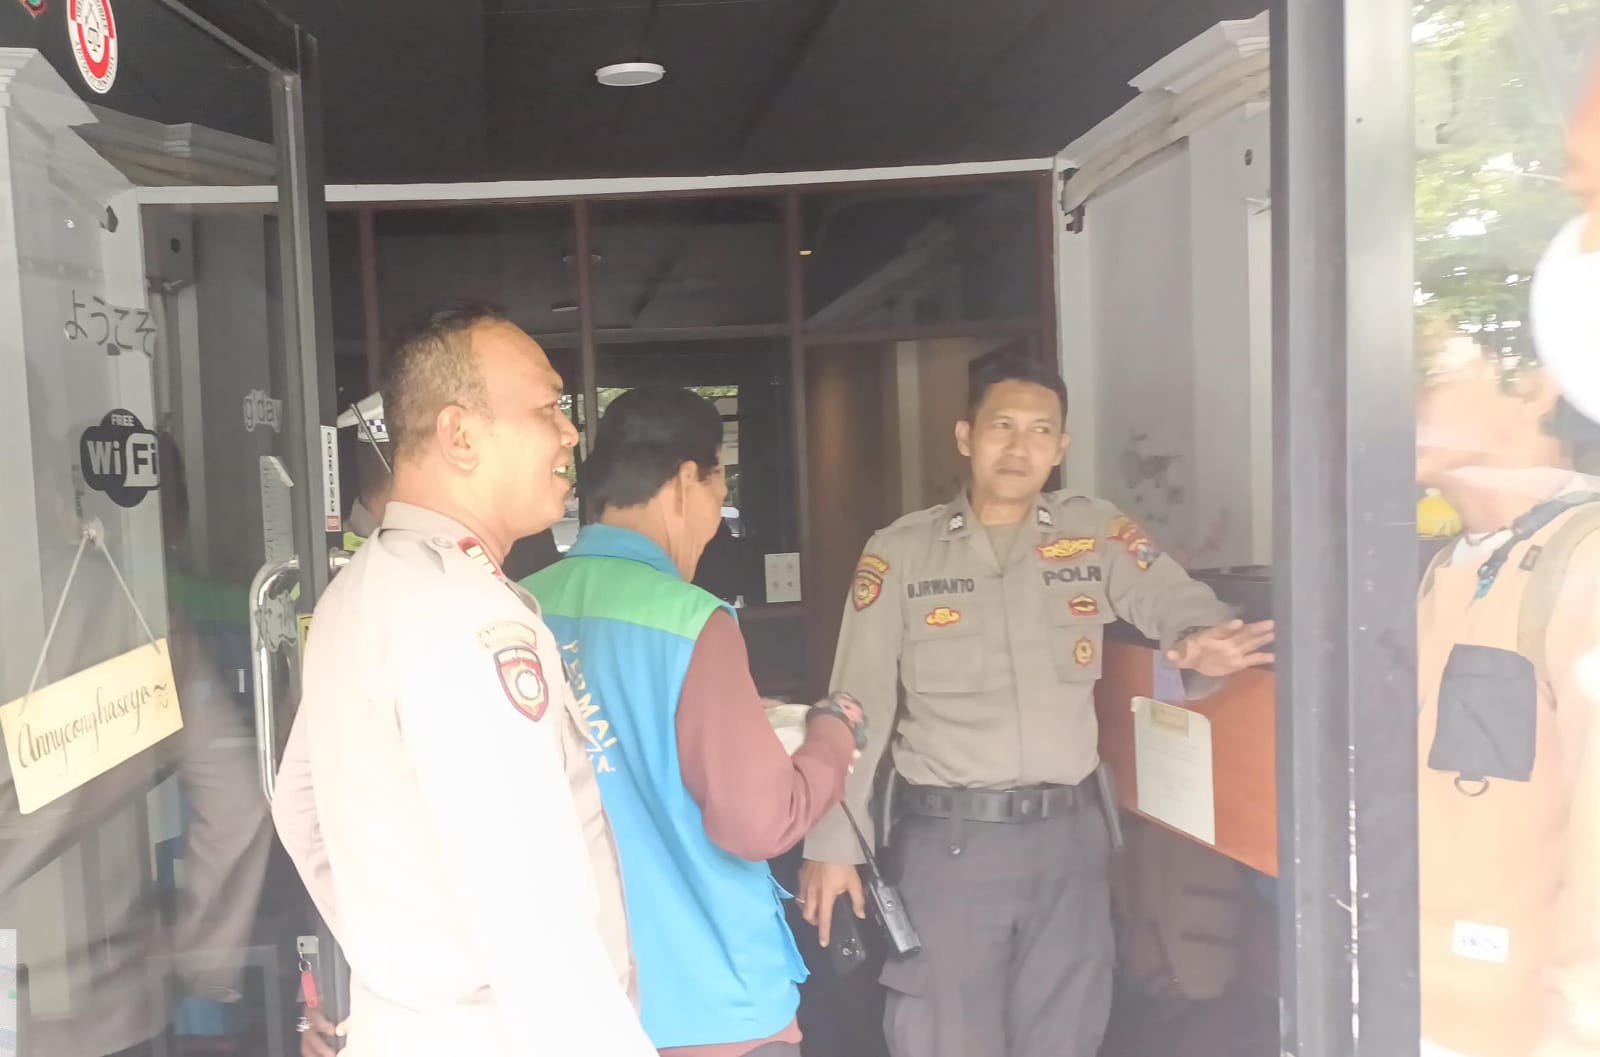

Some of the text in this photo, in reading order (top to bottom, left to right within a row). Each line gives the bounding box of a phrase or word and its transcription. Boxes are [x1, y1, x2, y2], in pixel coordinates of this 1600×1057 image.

[64, 290, 156, 358] ようこそ
[111, 414, 135, 427] FREE
[1043, 566, 1102, 586] POLRI
